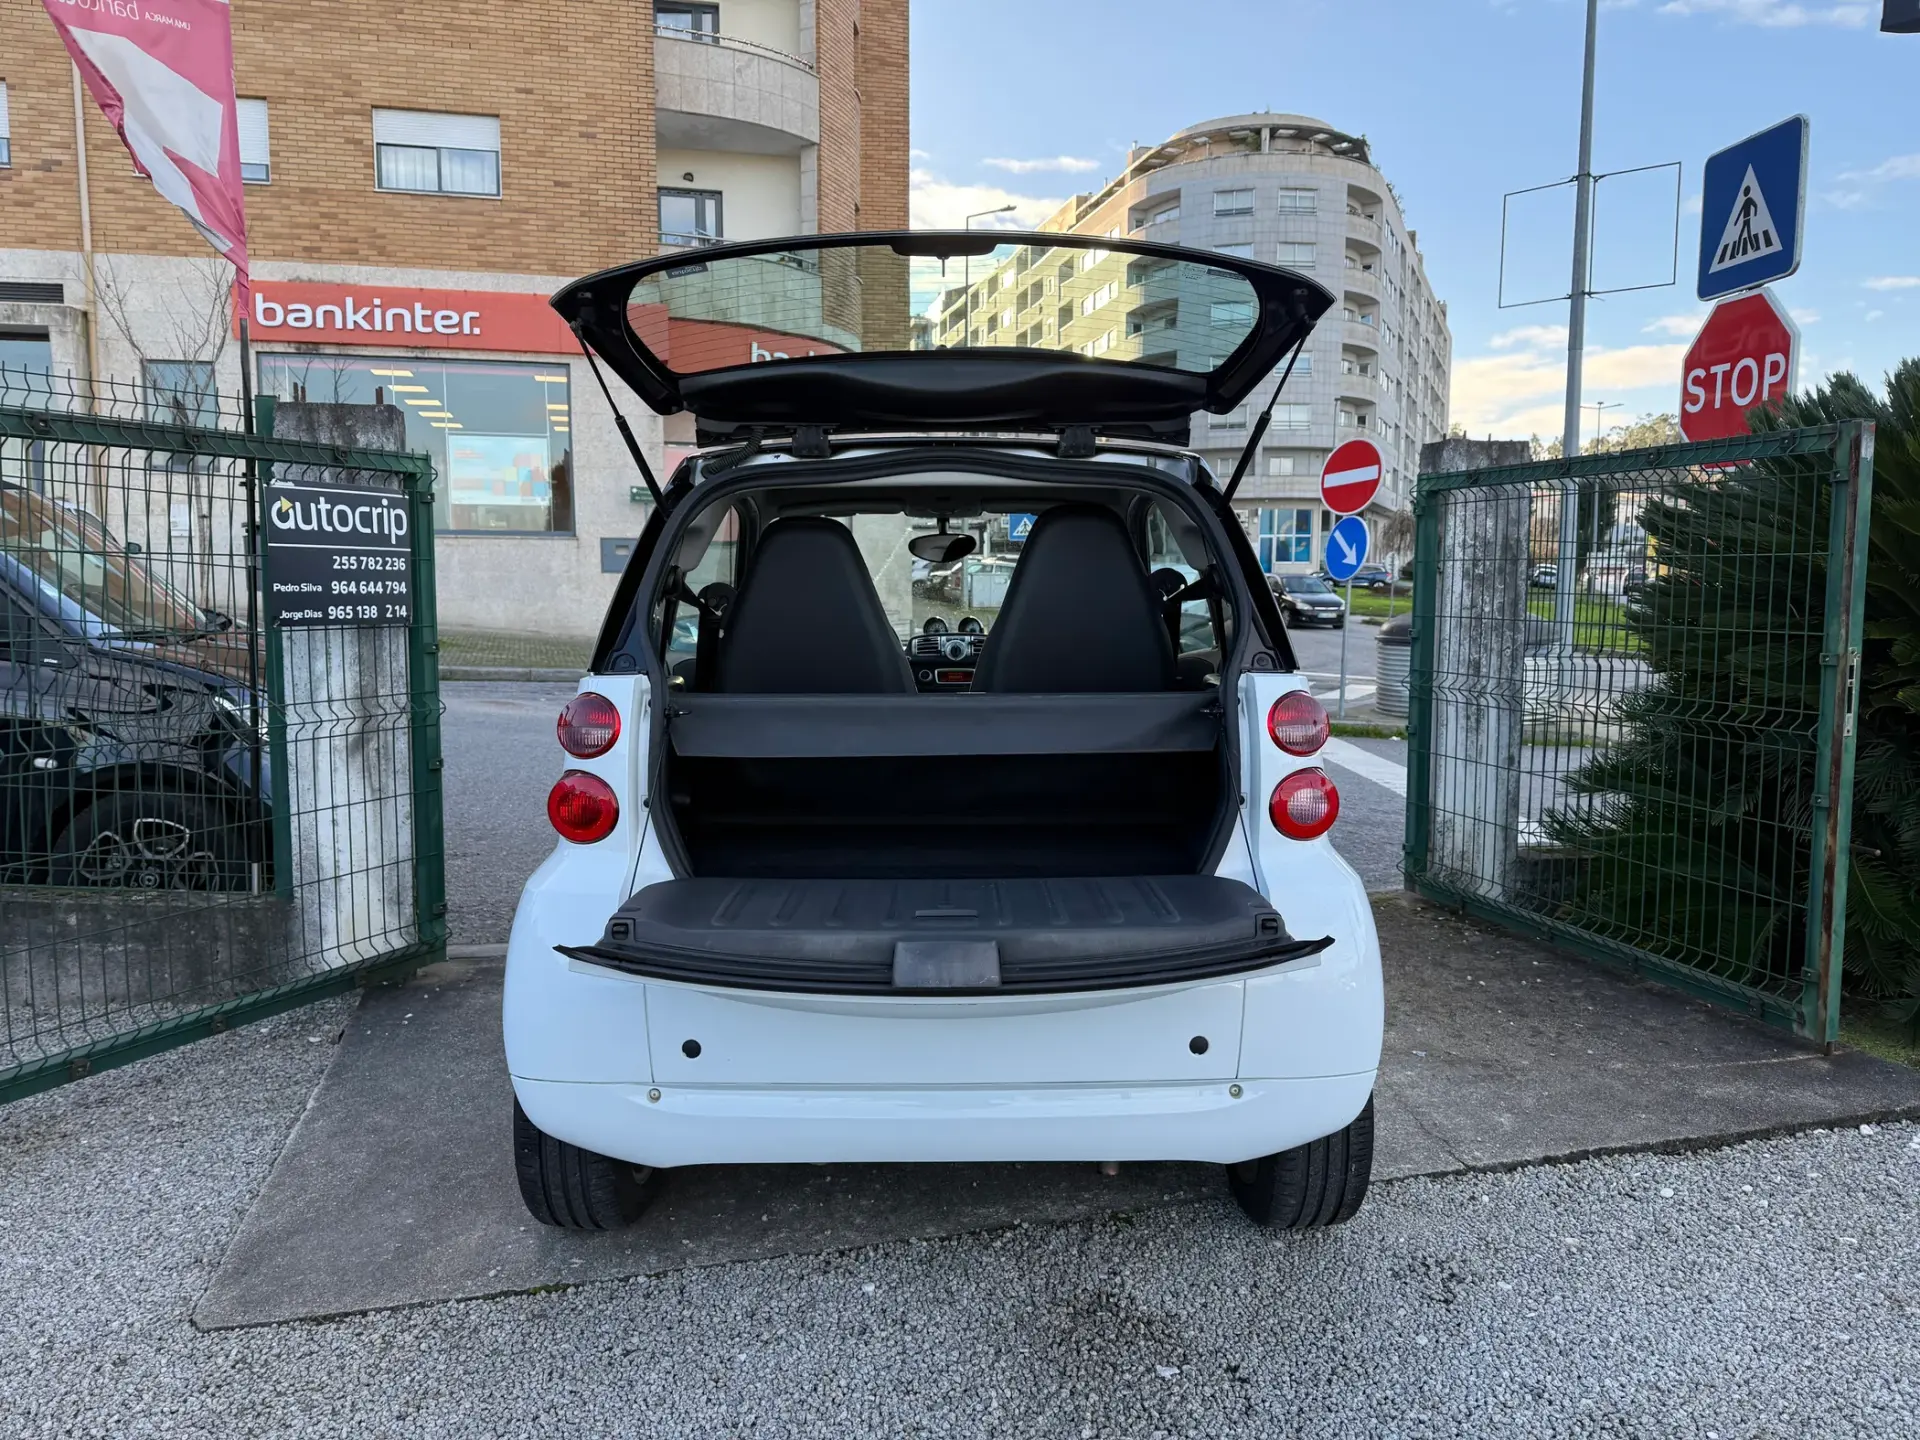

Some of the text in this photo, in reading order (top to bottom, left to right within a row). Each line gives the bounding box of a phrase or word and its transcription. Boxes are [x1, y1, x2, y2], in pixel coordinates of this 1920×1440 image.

[1684, 352, 1786, 413] STOP
[271, 496, 407, 544] autocrip
[332, 556, 406, 571] 255 782 236
[273, 581, 407, 594] Pedro Silva 964 644 794
[280, 605, 407, 620] Jorge Dias 965 138 214
